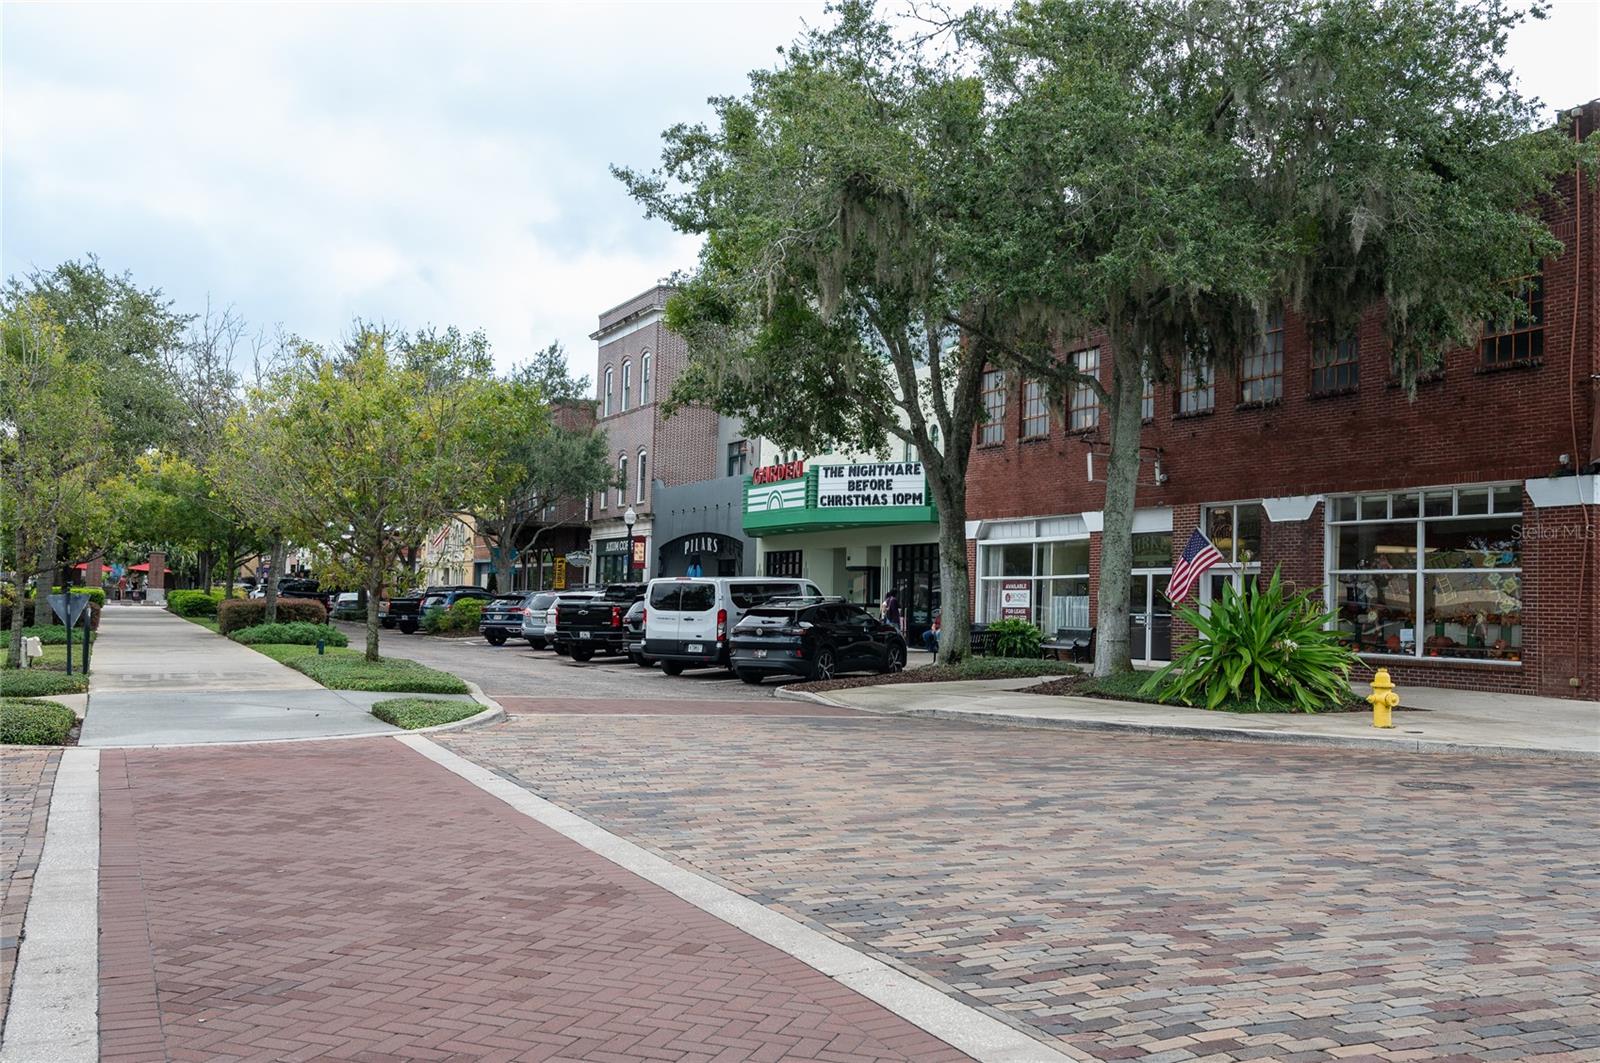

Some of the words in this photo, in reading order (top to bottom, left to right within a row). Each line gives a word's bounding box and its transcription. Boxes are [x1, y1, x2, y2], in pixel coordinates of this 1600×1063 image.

[752, 461, 803, 485] GARDEN
[822, 466, 845, 479] THE
[848, 463, 922, 477] NIGHTMARE
[847, 479, 893, 492] BEFORE
[820, 493, 889, 507] CHRISTMAS
[684, 536, 718, 555] PILARS
